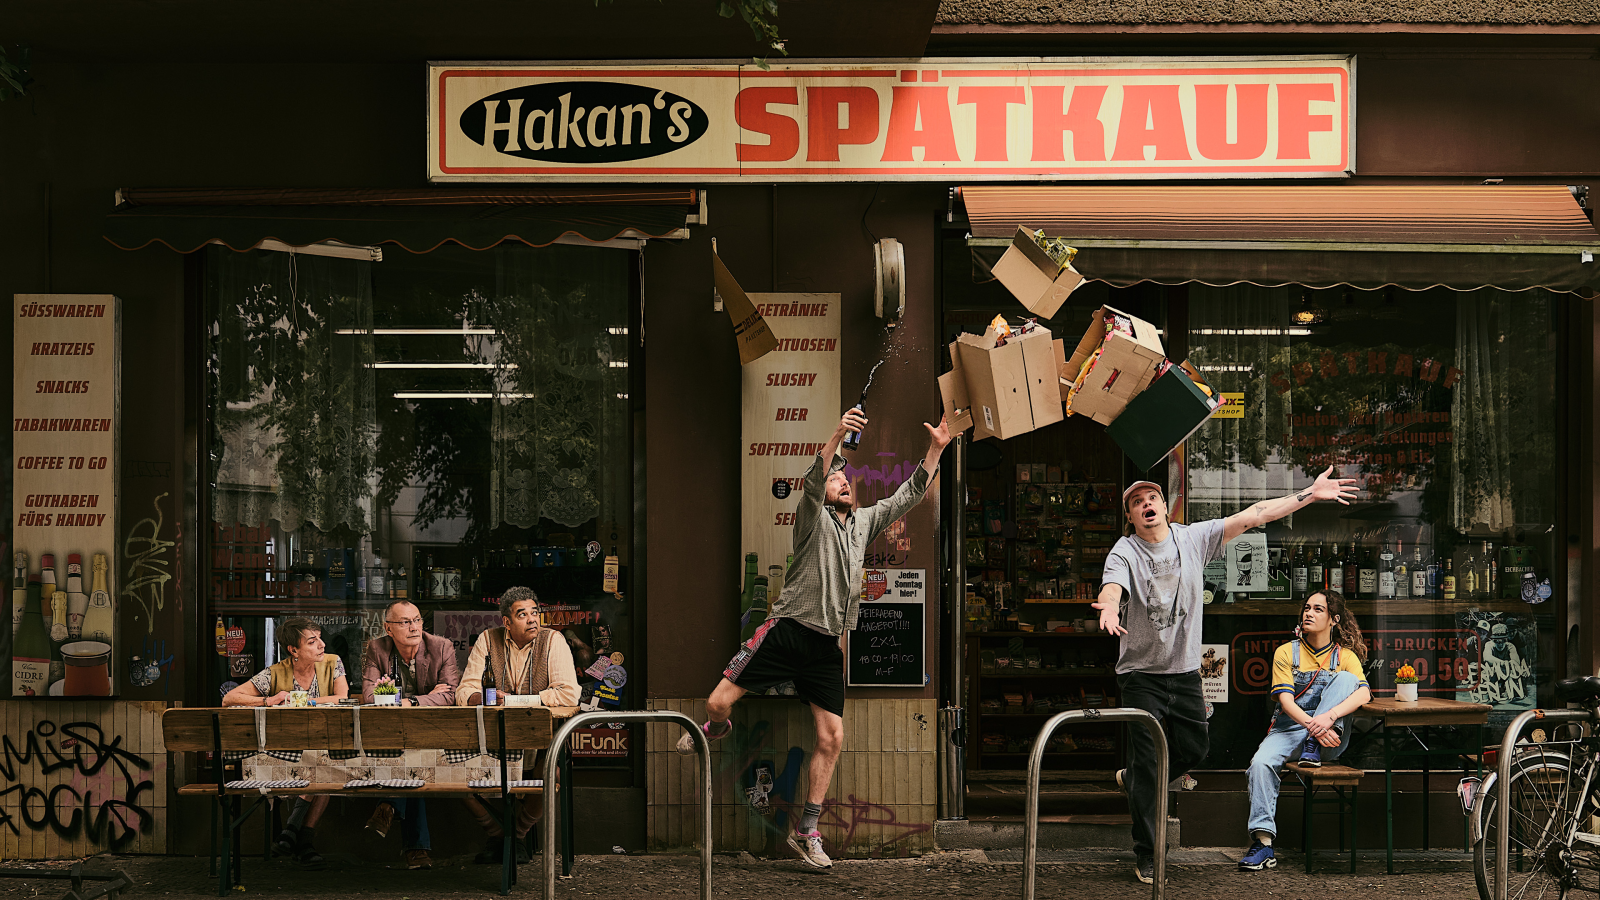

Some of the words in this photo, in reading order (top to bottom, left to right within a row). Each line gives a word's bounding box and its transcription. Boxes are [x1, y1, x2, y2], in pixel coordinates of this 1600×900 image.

[735, 70, 1336, 162] SPÄTKAUF
[20, 302, 106, 317] SÜSSWAREN
[756, 301, 828, 317] GETRÄNKE
[948, 313, 993, 323] ACHTUN
[31, 342, 95, 356] KRATZEIS
[766, 373, 817, 386] SLUSHY
[1270, 350, 1465, 396] SPÄTKAUF
[36, 381, 89, 394] SNACKS
[775, 408, 808, 421] BIER
[14, 418, 111, 432] TABAKWAREN
[17, 457, 64, 470] COFFEE
[68, 457, 85, 470] TO
[88, 457, 107, 470] GO
[1411, 450, 1431, 464] Eis
[25, 495, 99, 508] GUTHABEN
[18, 511, 53, 527] FÜRS
[55, 513, 106, 527] HANDY
[211, 522, 271, 542] Tabak
[211, 548, 274, 568] Weine
[898, 571, 919, 579] Jeden
[895, 581, 922, 589] Sonntag
[858, 608, 903, 619] FEIERABEND
[1394, 637, 1468, 651] DRUCKEN
[15, 671, 43, 680] CIDRE
